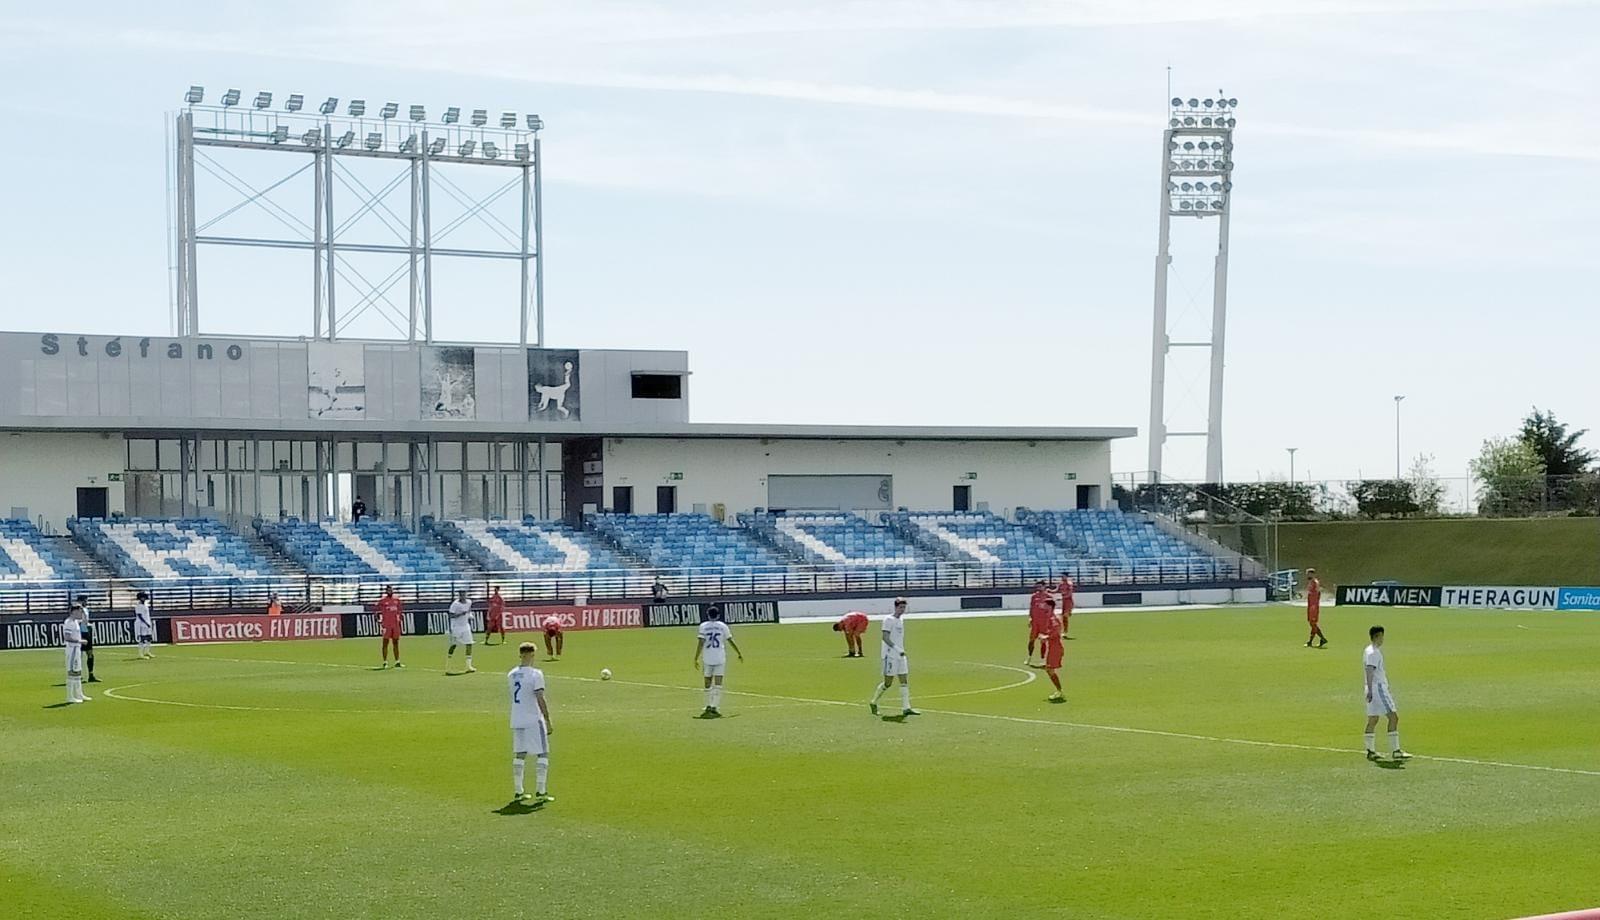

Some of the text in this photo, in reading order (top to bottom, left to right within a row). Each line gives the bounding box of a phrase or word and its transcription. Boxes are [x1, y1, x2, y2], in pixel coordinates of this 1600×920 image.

[41, 333, 242, 361] Stéfano
[1345, 588, 1431, 604] NIVEA MEN
[1445, 589, 1555, 606] THERAGUN
[356, 613, 415, 636] ADIDOM
[503, 608, 641, 629] Emires FLY BETTER
[649, 602, 774, 626] ADIDAS.COM ADIDAS.COM
[7, 620, 157, 649] ADIDAS.CO ADIDAS.CM
[176, 617, 338, 640] Emirates FLY BETTER
[514, 681, 522, 704] 2
